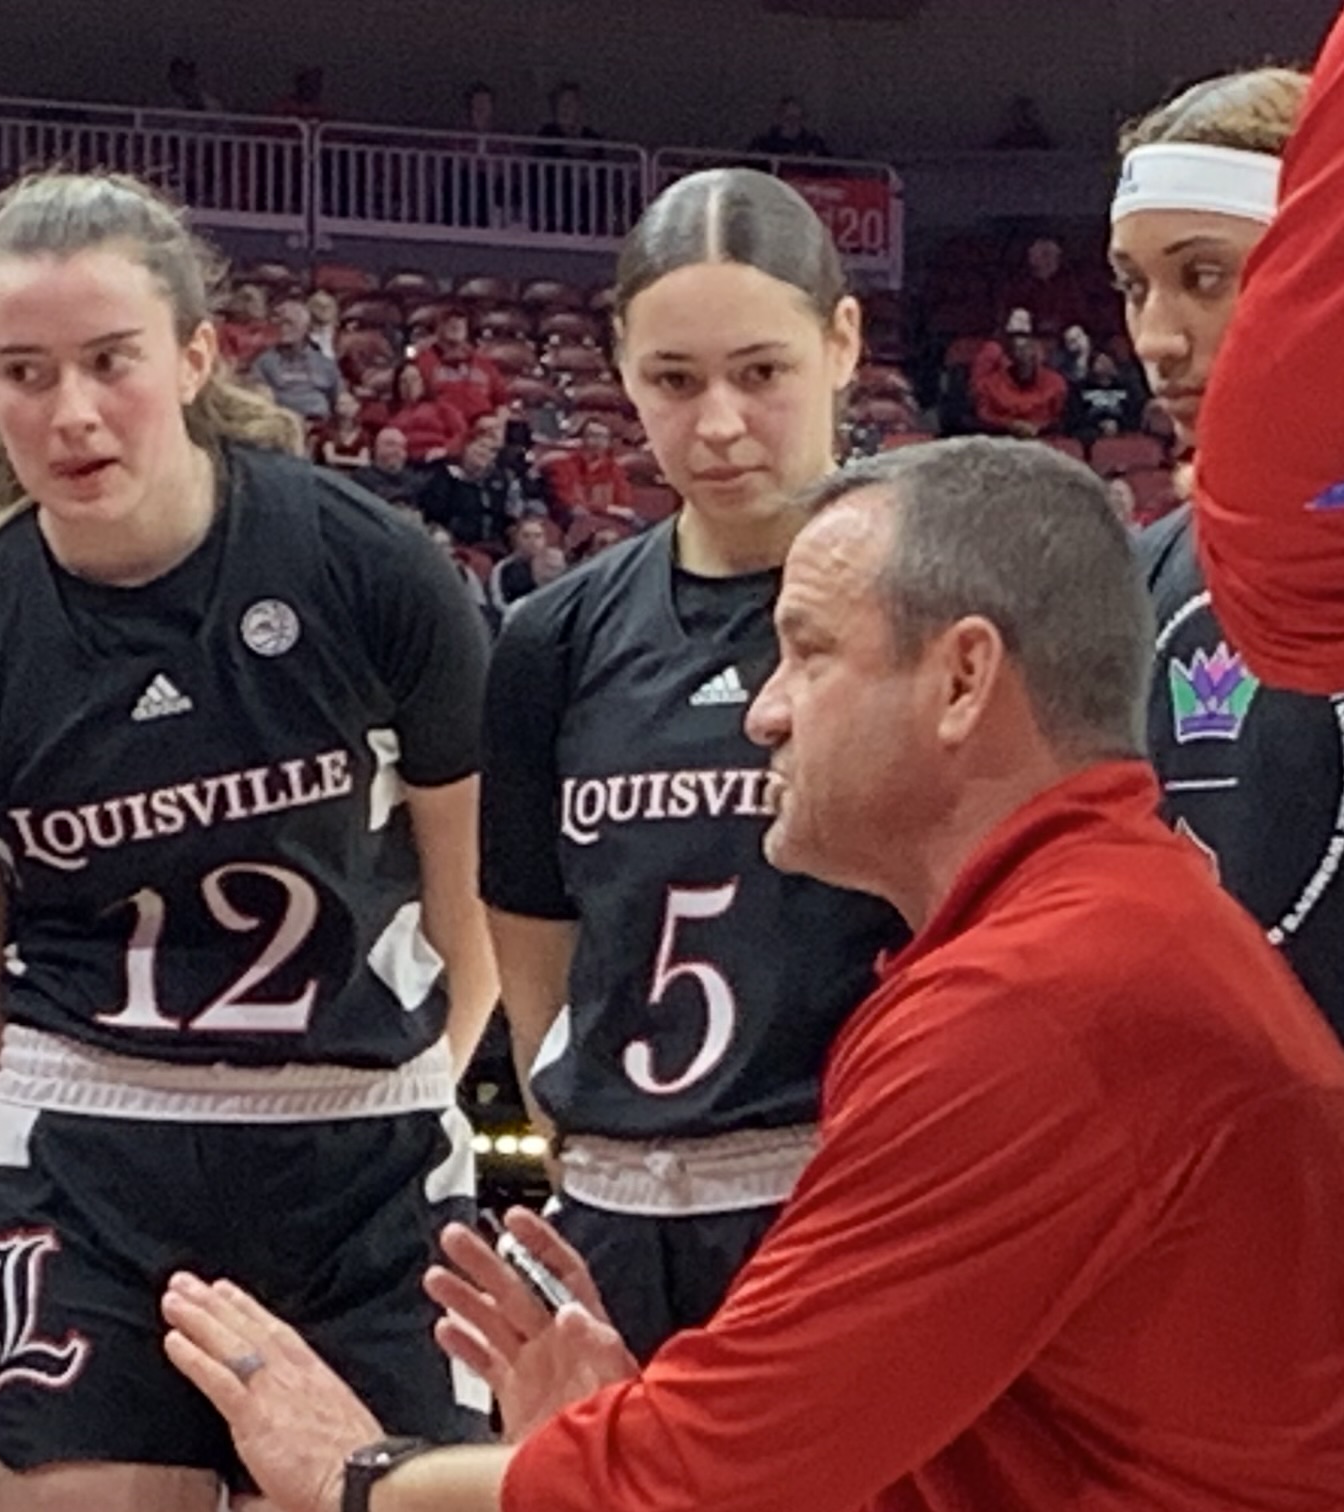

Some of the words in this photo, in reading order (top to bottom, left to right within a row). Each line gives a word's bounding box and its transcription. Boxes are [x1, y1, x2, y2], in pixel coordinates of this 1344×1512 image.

[837, 206, 885, 249] 20
[9, 749, 354, 869] LOUISVILLE
[96, 861, 320, 1033] 12
[622, 874, 740, 1095] 5
